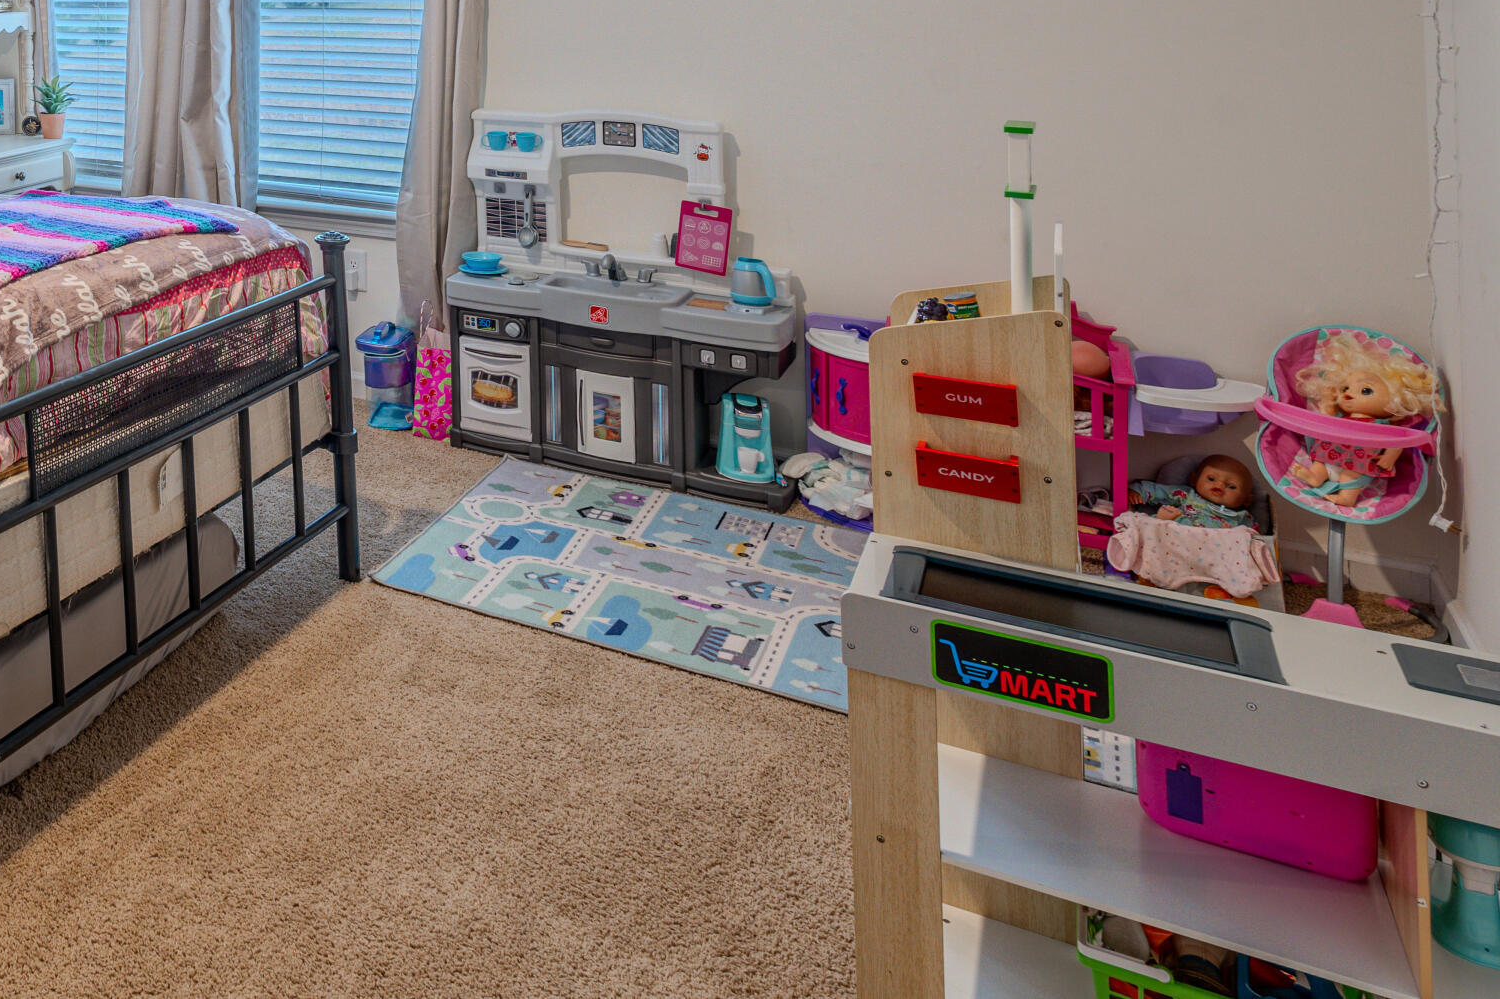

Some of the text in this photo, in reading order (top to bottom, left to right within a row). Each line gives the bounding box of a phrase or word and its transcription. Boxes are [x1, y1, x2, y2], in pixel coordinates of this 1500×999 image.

[945, 393, 982, 406] GUM
[938, 467, 995, 484] CANDY
[1000, 671, 1097, 714] MART
